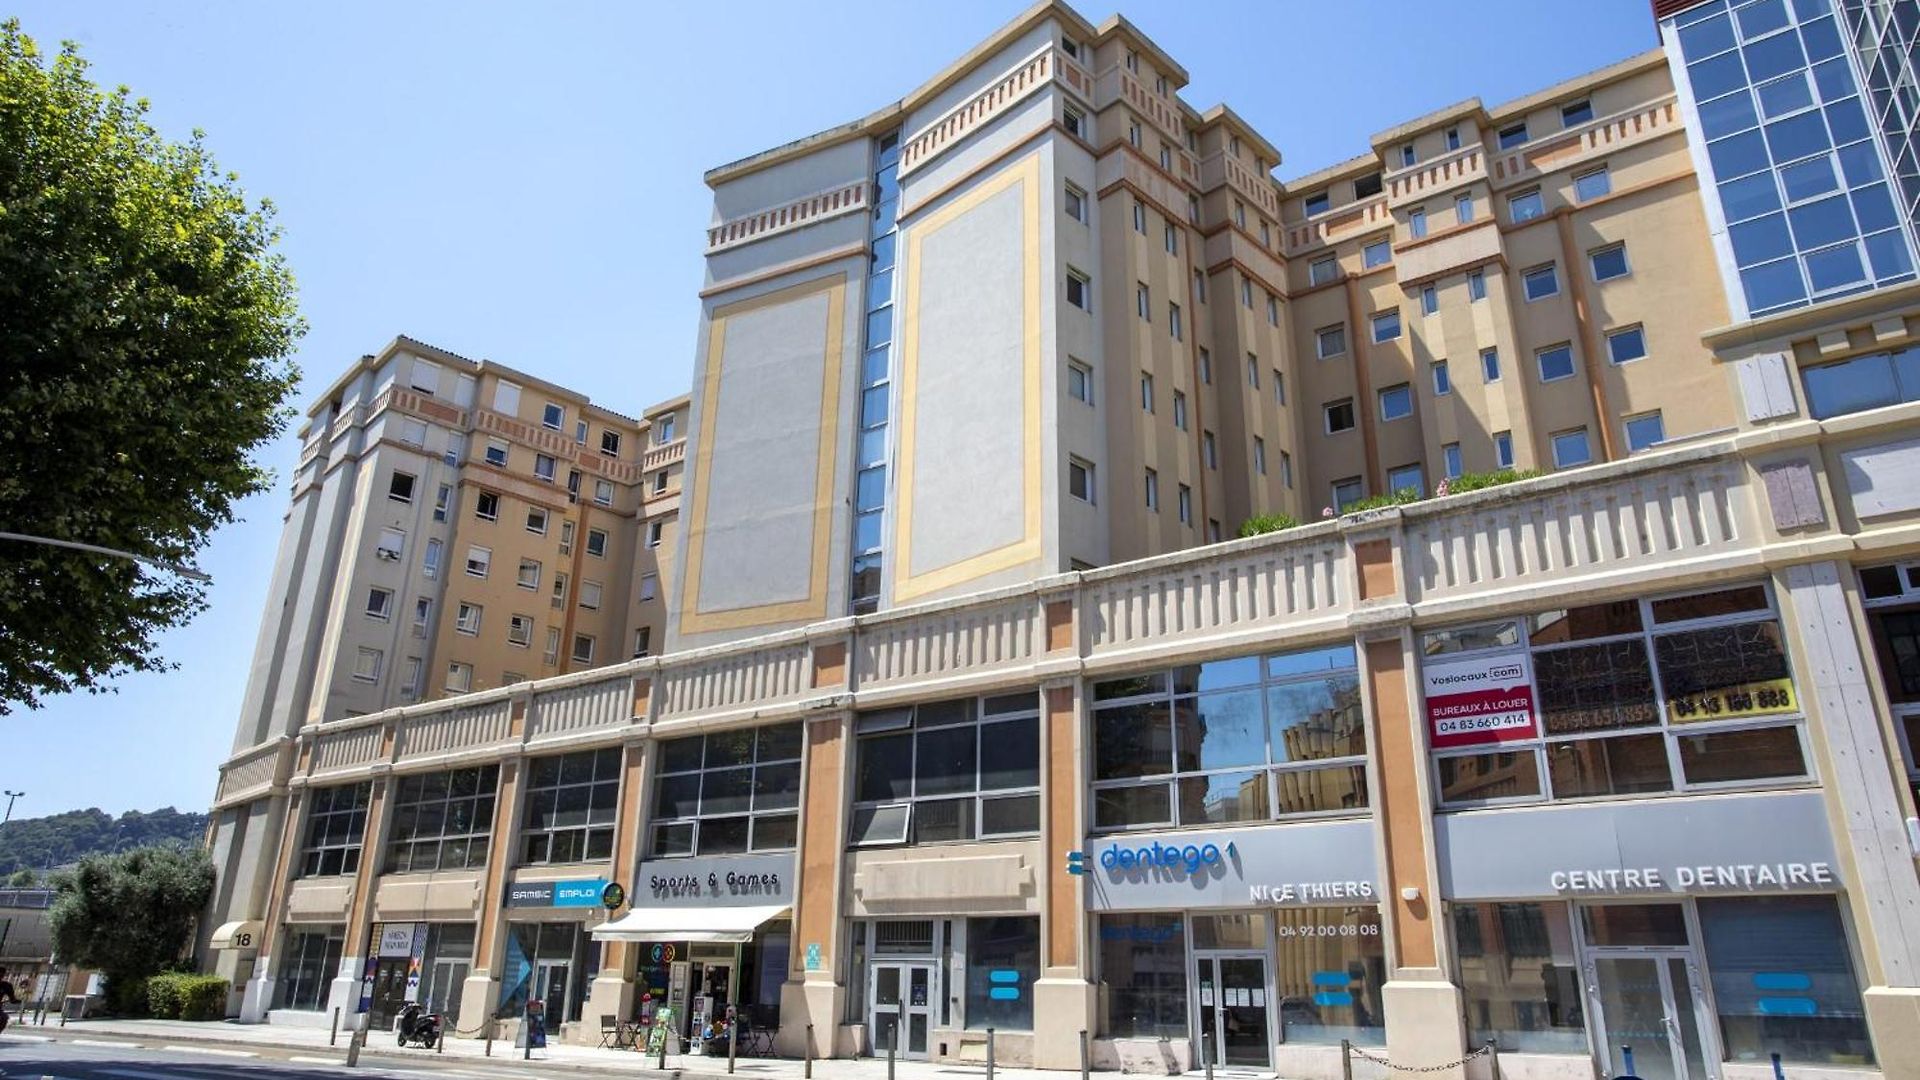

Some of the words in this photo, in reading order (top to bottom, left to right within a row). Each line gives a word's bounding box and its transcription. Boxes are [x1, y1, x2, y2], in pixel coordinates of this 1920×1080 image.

[1430, 672, 1488, 685] Voslocaux
[1432, 703, 1481, 716] BUREAUX
[1482, 700, 1491, 711] À
[1493, 698, 1529, 710] LOUER
[1439, 721, 1457, 732] 04
[1459, 719, 1475, 730] 83
[1476, 716, 1501, 728] 660
[1503, 713, 1526, 725] 414
[1101, 840, 1220, 873] dentego
[650, 874, 698, 890] Sports
[707, 872, 718, 887] &
[726, 871, 779, 886] Games
[1550, 868, 1661, 890] CENTRE
[1676, 862, 1832, 887] DENTAIRE
[559, 888, 596, 898] EMPLOI
[1250, 883, 1294, 903] NICE
[1299, 880, 1373, 900] THIERS
[1279, 925, 1297, 937] 04
[1299, 925, 1316, 937] 92
[1318, 925, 1337, 937] 00
[1339, 924, 1358, 936] 08
[1360, 924, 1379, 936] 08
[235, 933, 252, 947] 18
